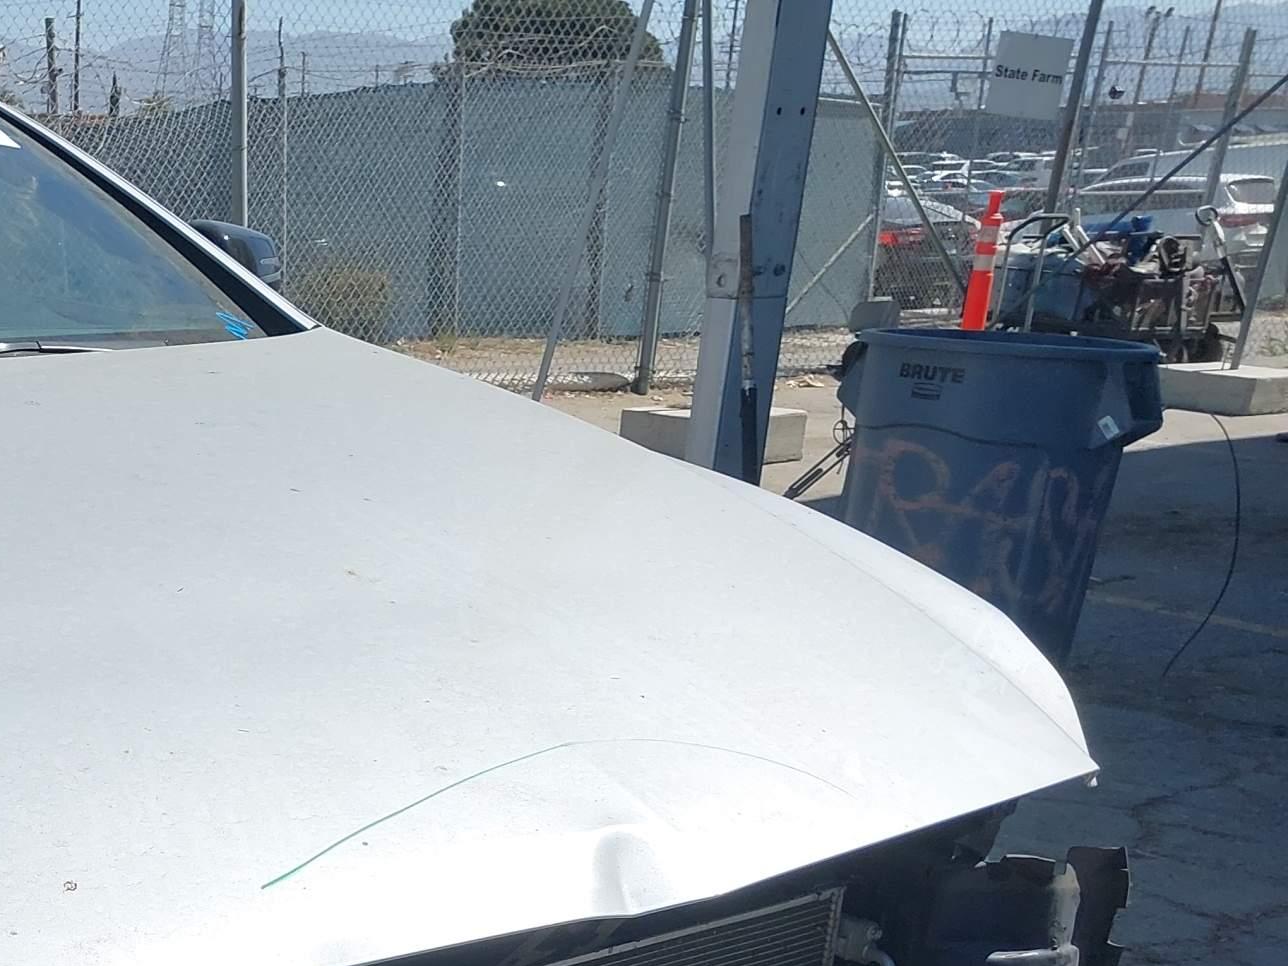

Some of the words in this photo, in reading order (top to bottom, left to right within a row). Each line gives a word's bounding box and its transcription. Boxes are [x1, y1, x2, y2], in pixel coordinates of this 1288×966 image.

[994, 64, 1029, 81] State
[1031, 69, 1064, 85] Farm
[899, 362, 966, 384] BRUTE
